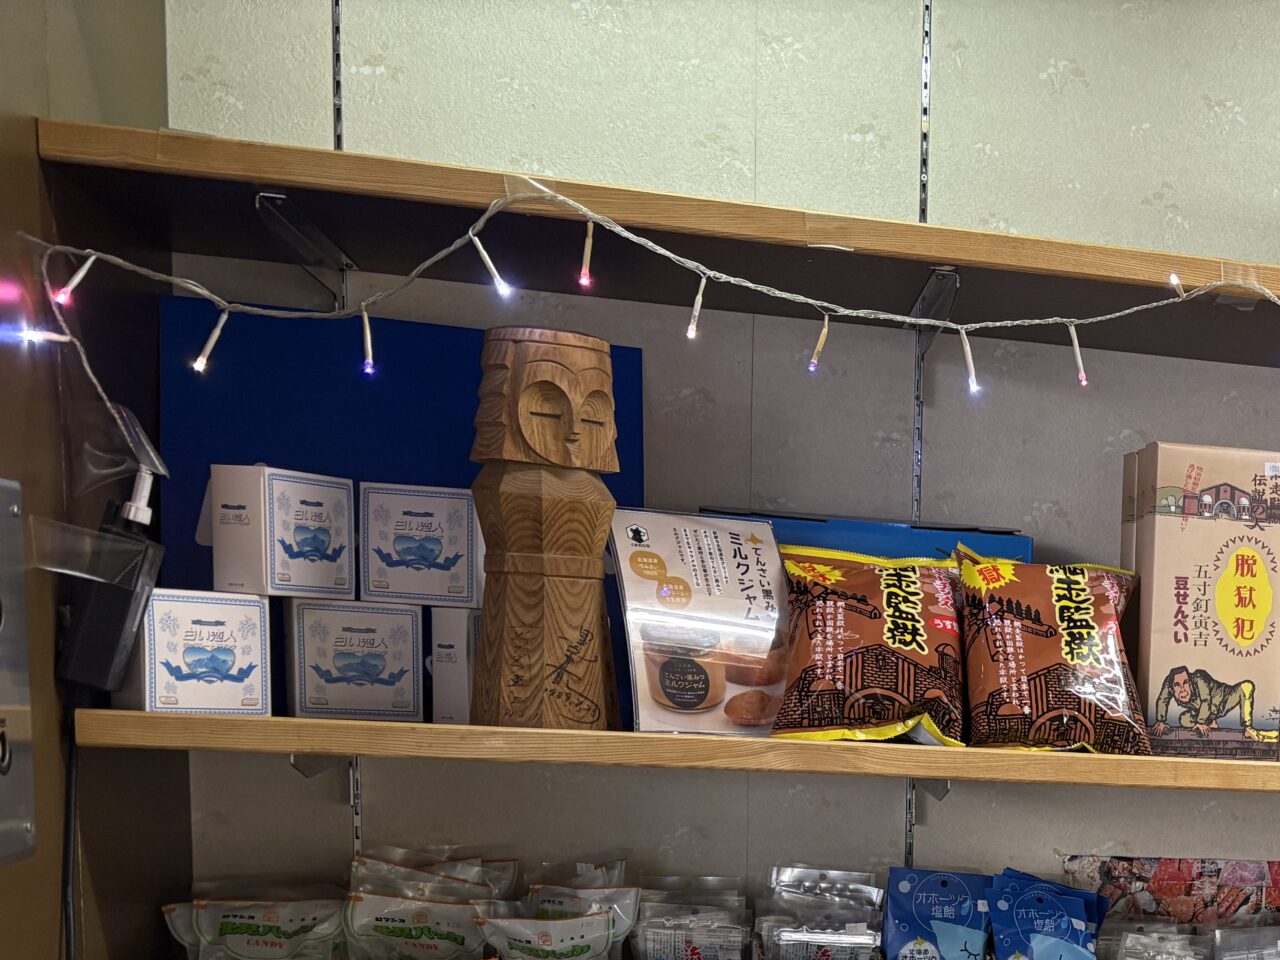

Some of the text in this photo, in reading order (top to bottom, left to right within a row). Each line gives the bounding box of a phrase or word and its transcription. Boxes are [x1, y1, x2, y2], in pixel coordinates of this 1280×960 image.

[729, 532, 760, 620] ミルクジャム
[1174, 576, 1189, 644] 豆せんべい
[1192, 564, 1212, 647] 五寸釘寅吉
[1234, 554, 1257, 640] 脱獄犯
[916, 893, 970, 905] オホーツク
[931, 905, 955, 919] 塩飴
[246, 939, 286, 951] CANDY
[1033, 919, 1055, 931] 塩飴
